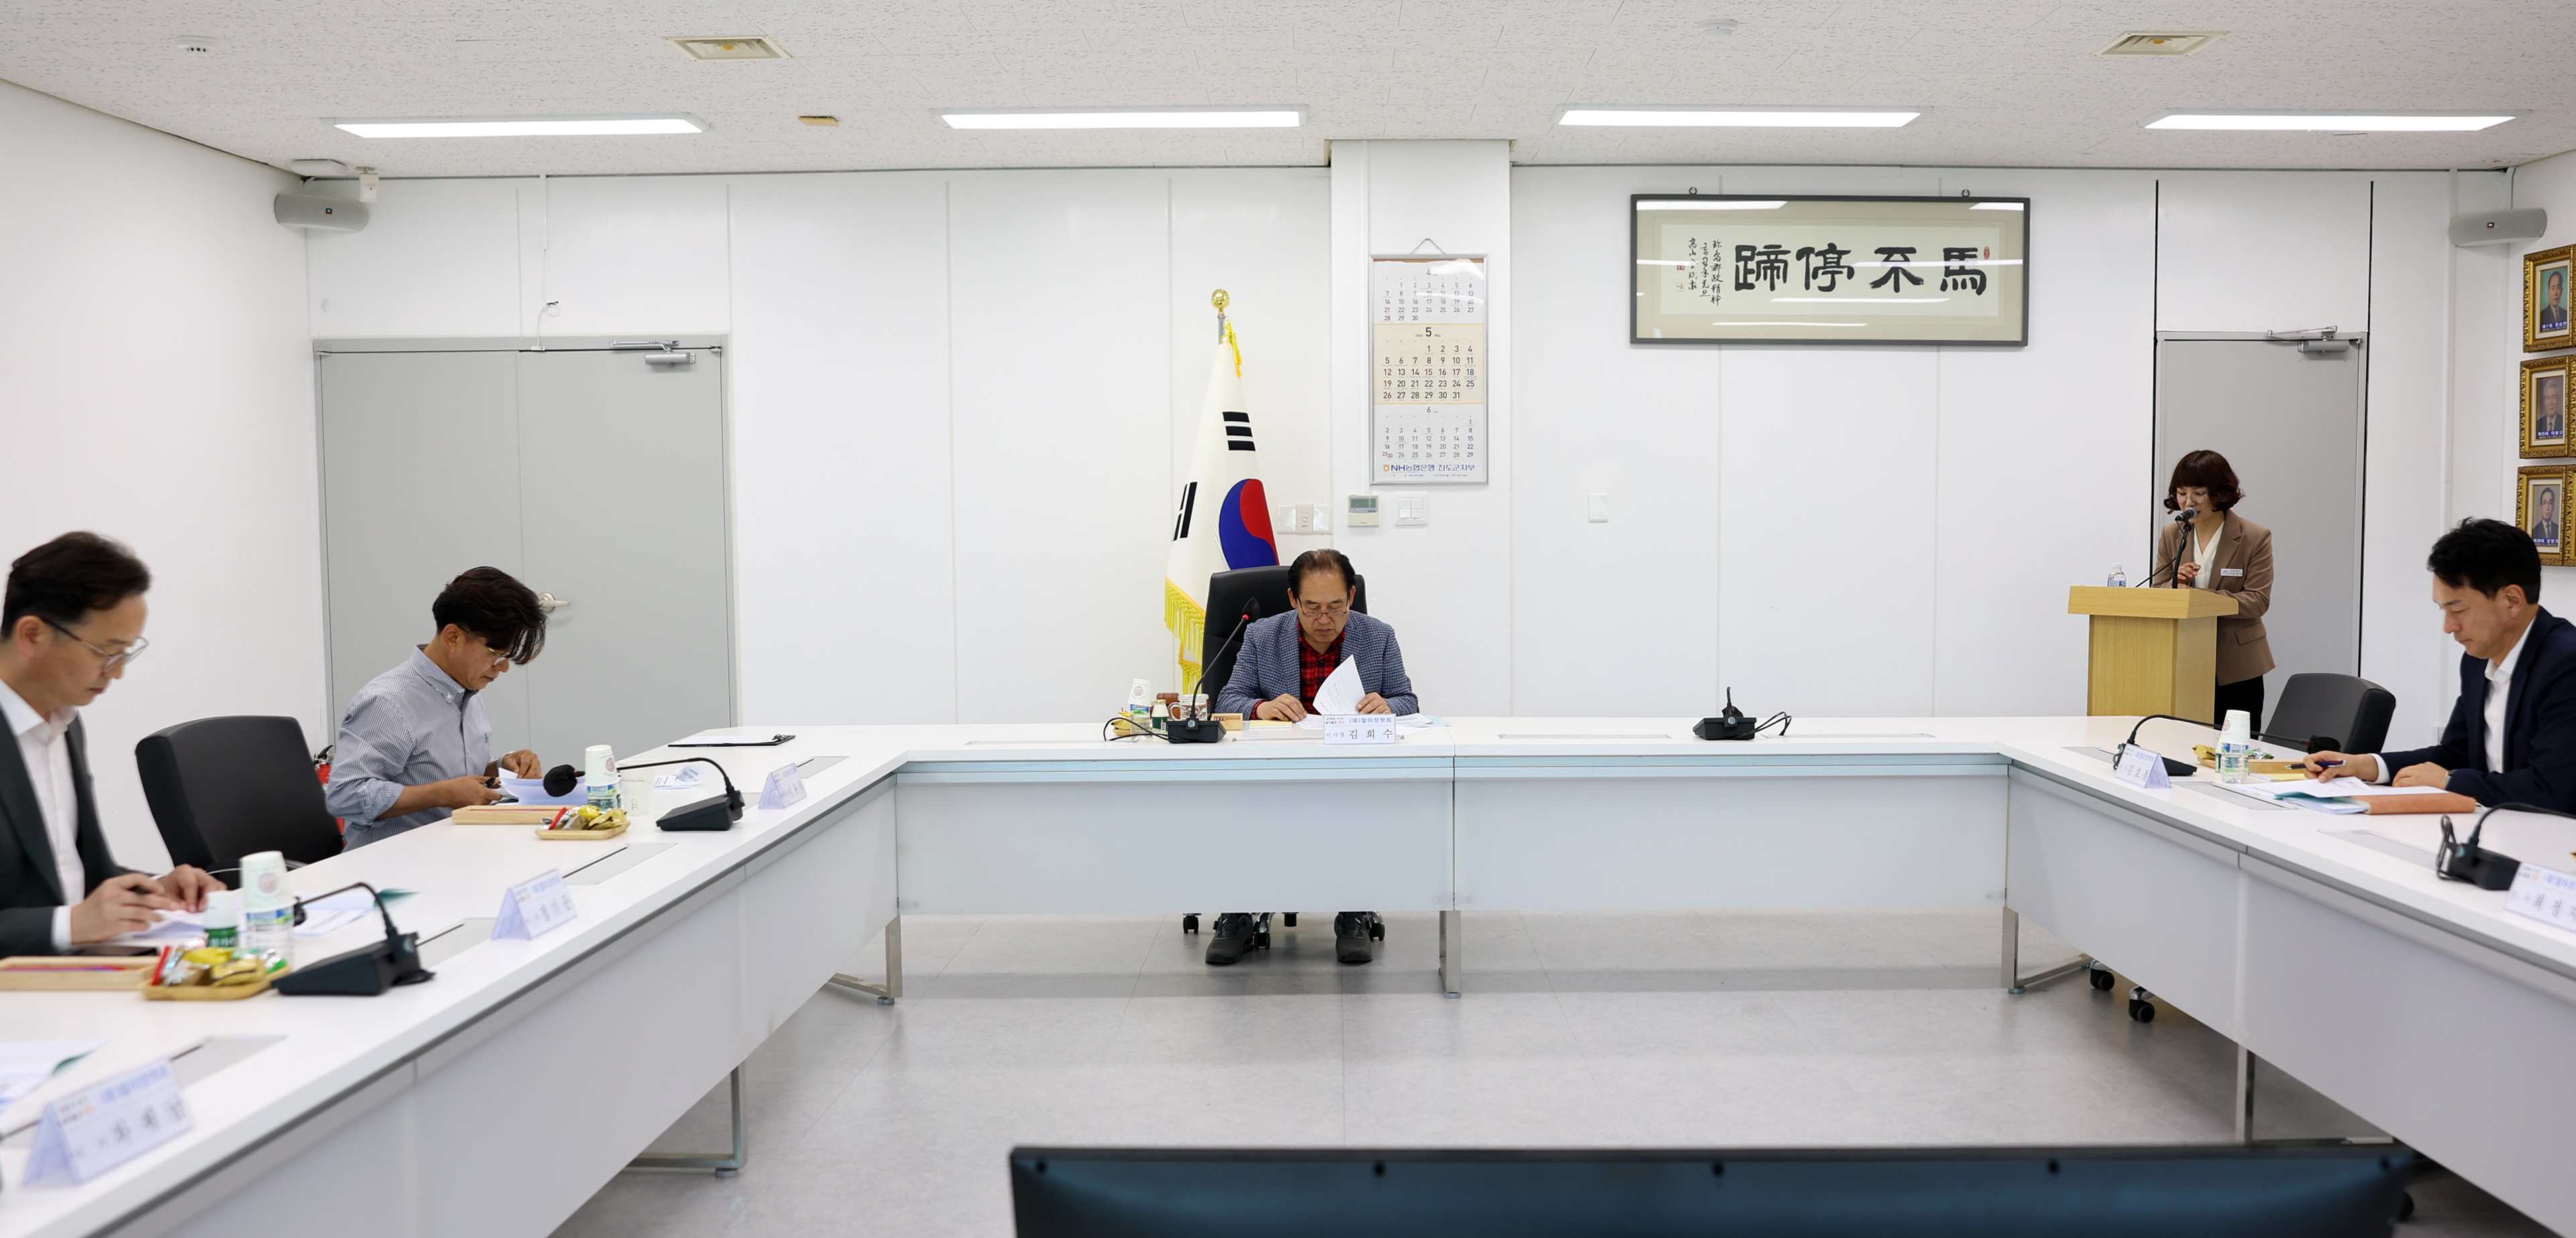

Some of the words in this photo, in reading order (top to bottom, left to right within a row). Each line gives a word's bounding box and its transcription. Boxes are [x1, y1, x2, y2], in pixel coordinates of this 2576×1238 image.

[1425, 327, 1432, 337] 5
[1440, 345, 1445, 353] 2
[1454, 345, 1460, 353] 3
[1385, 356, 1390, 364] 5
[1399, 356, 1404, 364] 6
[1413, 356, 1418, 364] 7
[1427, 356, 1431, 364] 8
[1440, 356, 1445, 364] 9
[1452, 356, 1460, 364] 10
[1466, 356, 1473, 364] 11
[1383, 368, 1392, 376] 12
[1397, 368, 1406, 376] 13
[1424, 368, 1433, 376] 15
[1452, 368, 1461, 376] 17
[1466, 368, 1474, 376] 18
[1397, 380, 1406, 388] 20
[1411, 380, 1419, 388] 21
[1424, 380, 1433, 388] 22
[1438, 380, 1447, 388] 23
[1383, 391, 1392, 399] 26
[1397, 391, 1406, 399] 27
[1411, 391, 1420, 399] 28
[1424, 391, 1433, 399] 29
[1438, 391, 1447, 399] 30
[1452, 391, 1460, 399] 31
[1349, 729, 1393, 740] 김희수
